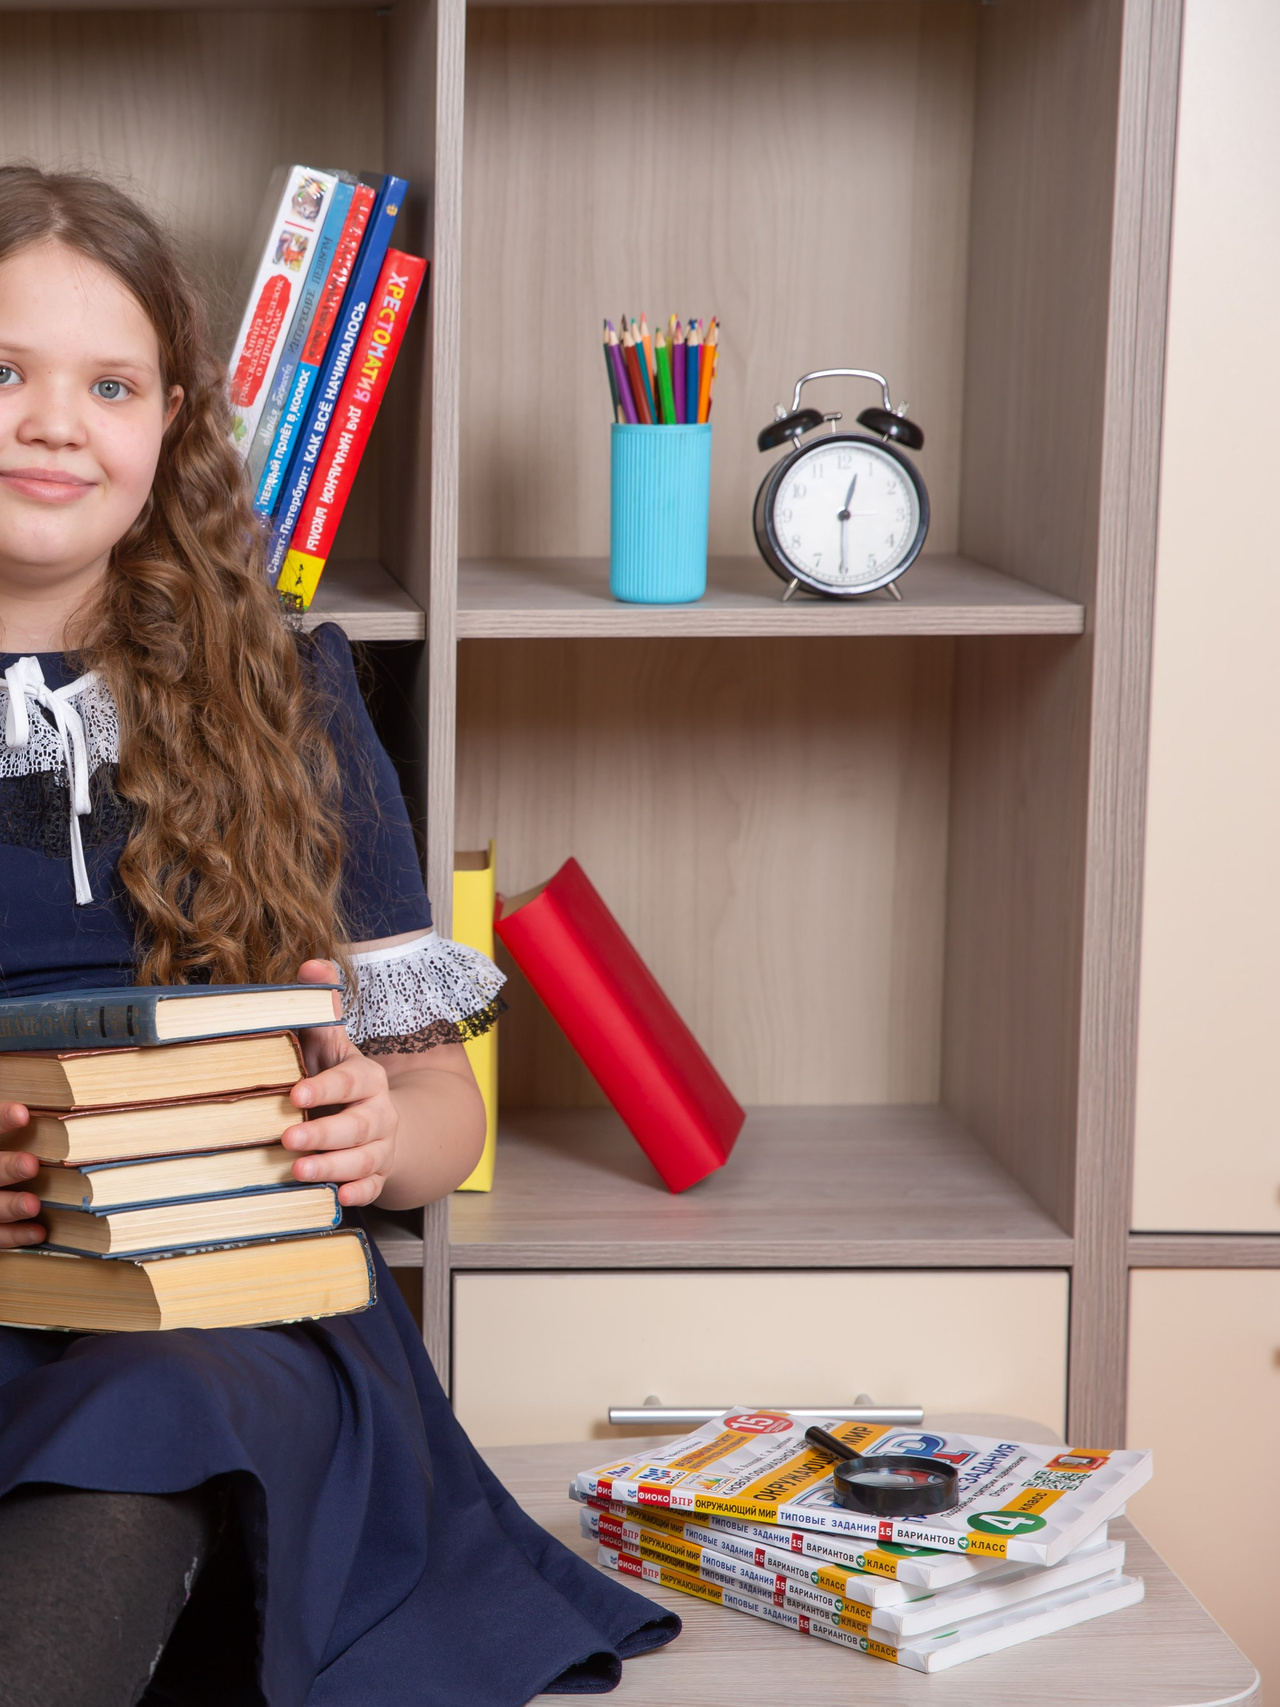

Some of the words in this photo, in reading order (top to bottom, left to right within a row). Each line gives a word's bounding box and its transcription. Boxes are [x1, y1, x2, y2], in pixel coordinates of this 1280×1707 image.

[239, 335, 266, 403] рассказов
[265, 279, 284, 322] сказок
[243, 318, 263, 358] Книга
[261, 308, 283, 363] природе
[289, 289, 316, 355] ИНТЕРЕСНЕЕ
[353, 271, 410, 404] ХРЕСТОМАТИЯ
[259, 459, 282, 505] ПЕРВЫЙ
[274, 424, 293, 458] ПОЛЁТ
[289, 369, 311, 414] КОСМОС
[267, 466, 311, 574] Санкт-Петербург:
[304, 434, 322, 463] КАК
[314, 401, 333, 433] ВСЁ
[325, 301, 367, 399] НАЧИНАЛОСЬ
[319, 425, 354, 504] НАЧАЛЬНОЙ
[812, 463, 823, 479] 11
[837, 455, 852, 470] 12
[868, 462, 874, 477] 1
[793, 482, 807, 498] 10
[887, 481, 897, 495] 2
[305, 506, 328, 551] ШКОЛЫ
[783, 509, 793, 523] 9
[896, 508, 905, 522] 3
[791, 535, 801, 549] 8
[812, 553, 823, 568] 7
[867, 553, 877, 568] 5
[885, 533, 895, 548] 4
[839, 559, 849, 575] 6
[730, 1415, 774, 1430] 15
[840, 1426, 874, 1446] МИР
[729, 1475, 752, 1492] НОВОЙ
[749, 1449, 797, 1477] ОФИЦИАЛЬНОЙ
[963, 1443, 1020, 1484] ЗАДАНИЯ
[638, 1492, 670, 1503] ФИОКО
[671, 1497, 693, 1507] ВПР
[695, 1499, 756, 1515] ОКРУЖАЮЩИЙ
[758, 1508, 776, 1518] МИР
[780, 1511, 826, 1526] ТИПОВЫЕ
[831, 1519, 877, 1533] ЗАДАНИЯ
[897, 1529, 955, 1545] ВАРИАНТОВ
[971, 1540, 1006, 1553] КЛАСС
[979, 1514, 1036, 1530] 4
[1018, 1491, 1048, 1511] класс
[609, 1502, 626, 1513] ВПР
[627, 1507, 670, 1530] ОКРУЖАЮЩИЙ
[670, 1522, 684, 1534] МИР
[685, 1528, 718, 1546] ТИПОВЫЕ
[721, 1541, 753, 1559] ЗАДАНИЯ
[767, 1557, 809, 1579] ВАРИАНТОВ
[820, 1576, 845, 1591] КЛАСС
[711, 1516, 749, 1533] ТИПОВЫЕ
[752, 1528, 790, 1545] ЗАДАНИЯ
[806, 1543, 854, 1563] ВАРИАНТОВ
[867, 1559, 896, 1574] КЛАСС
[599, 1520, 621, 1534] ФИОКО
[622, 1528, 639, 1540] ВПР
[640, 1533, 686, 1556] ОКРУЖАЮЩИЙ
[686, 1548, 700, 1560] МИР
[702, 1555, 736, 1573] ТИПОВЫЕ
[740, 1568, 774, 1586] ЗАДАНИЯ
[789, 1585, 833, 1606] ВАРИАНТОВ
[844, 1604, 871, 1619] КЛАСС
[622, 1541, 639, 1552] ВПР
[640, 1547, 685, 1569] ОКРУЖАЮЩИЙ
[685, 1562, 699, 1574] МИР
[701, 1567, 735, 1586] ТИПОВЫЕ
[738, 1581, 772, 1600] ЗАДАНИЯ
[786, 1598, 830, 1619] ВАРИАНТОВ
[841, 1618, 868, 1632] КЛАСС
[618, 1560, 641, 1573] ФИОКО
[642, 1567, 659, 1579] ВПР
[661, 1572, 707, 1595] ОКРУЖАЮЩИЙ
[707, 1588, 722, 1599] МИР
[724, 1593, 759, 1612] ТИПОВЫЕ
[762, 1607, 798, 1625] ЗАДАНИЯ
[812, 1623, 858, 1645] ВАРИАНТОВ
[869, 1643, 897, 1658] КЛАСС
